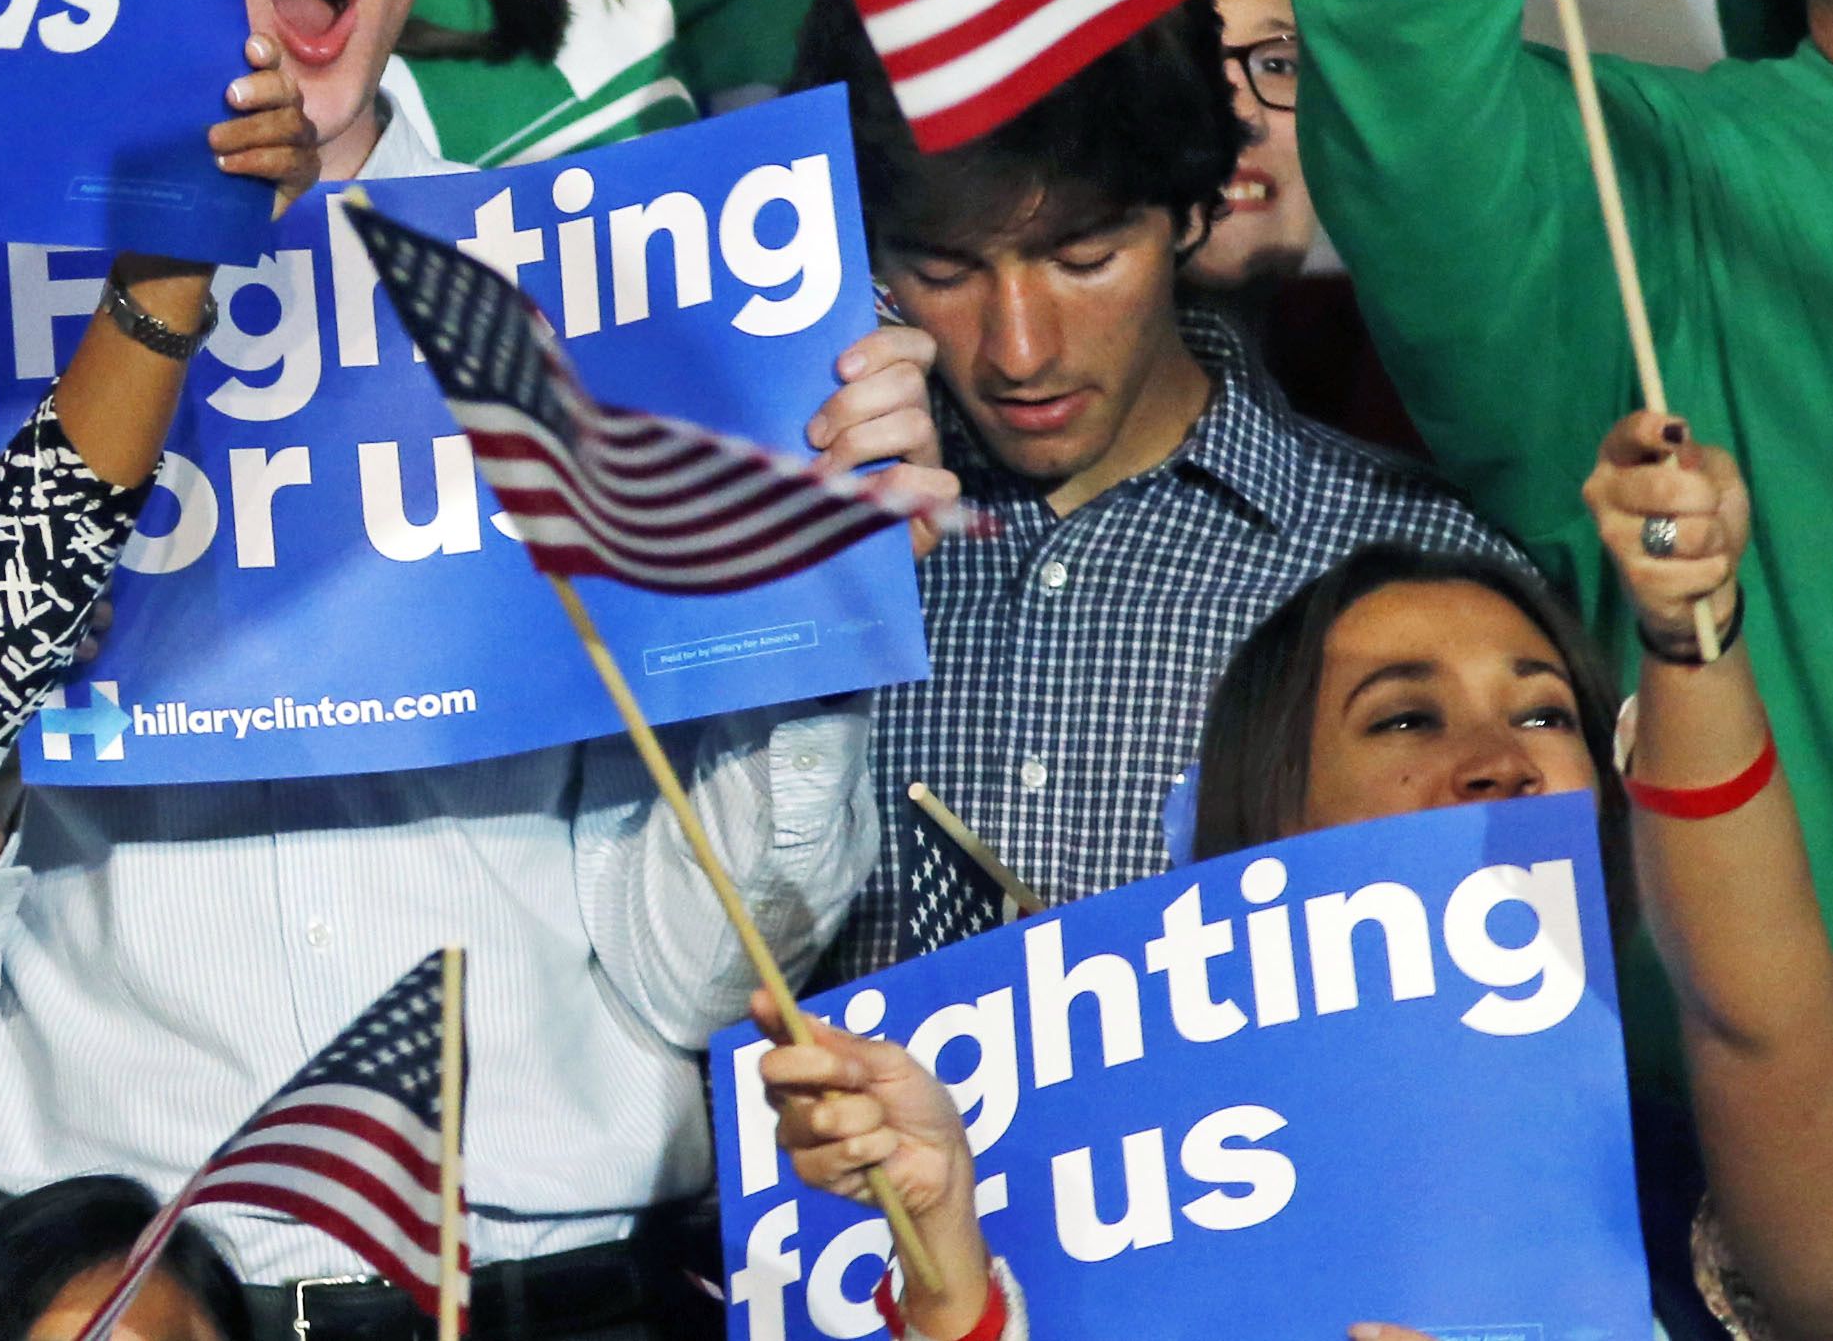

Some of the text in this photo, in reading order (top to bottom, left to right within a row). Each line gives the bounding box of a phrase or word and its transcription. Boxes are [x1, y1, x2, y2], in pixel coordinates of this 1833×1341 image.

[8, 153, 843, 422] Fghting
[116, 434, 525, 576] or u
[132, 688, 477, 739] hillaryclinton.com
[730, 1104, 1297, 1341] fo us
